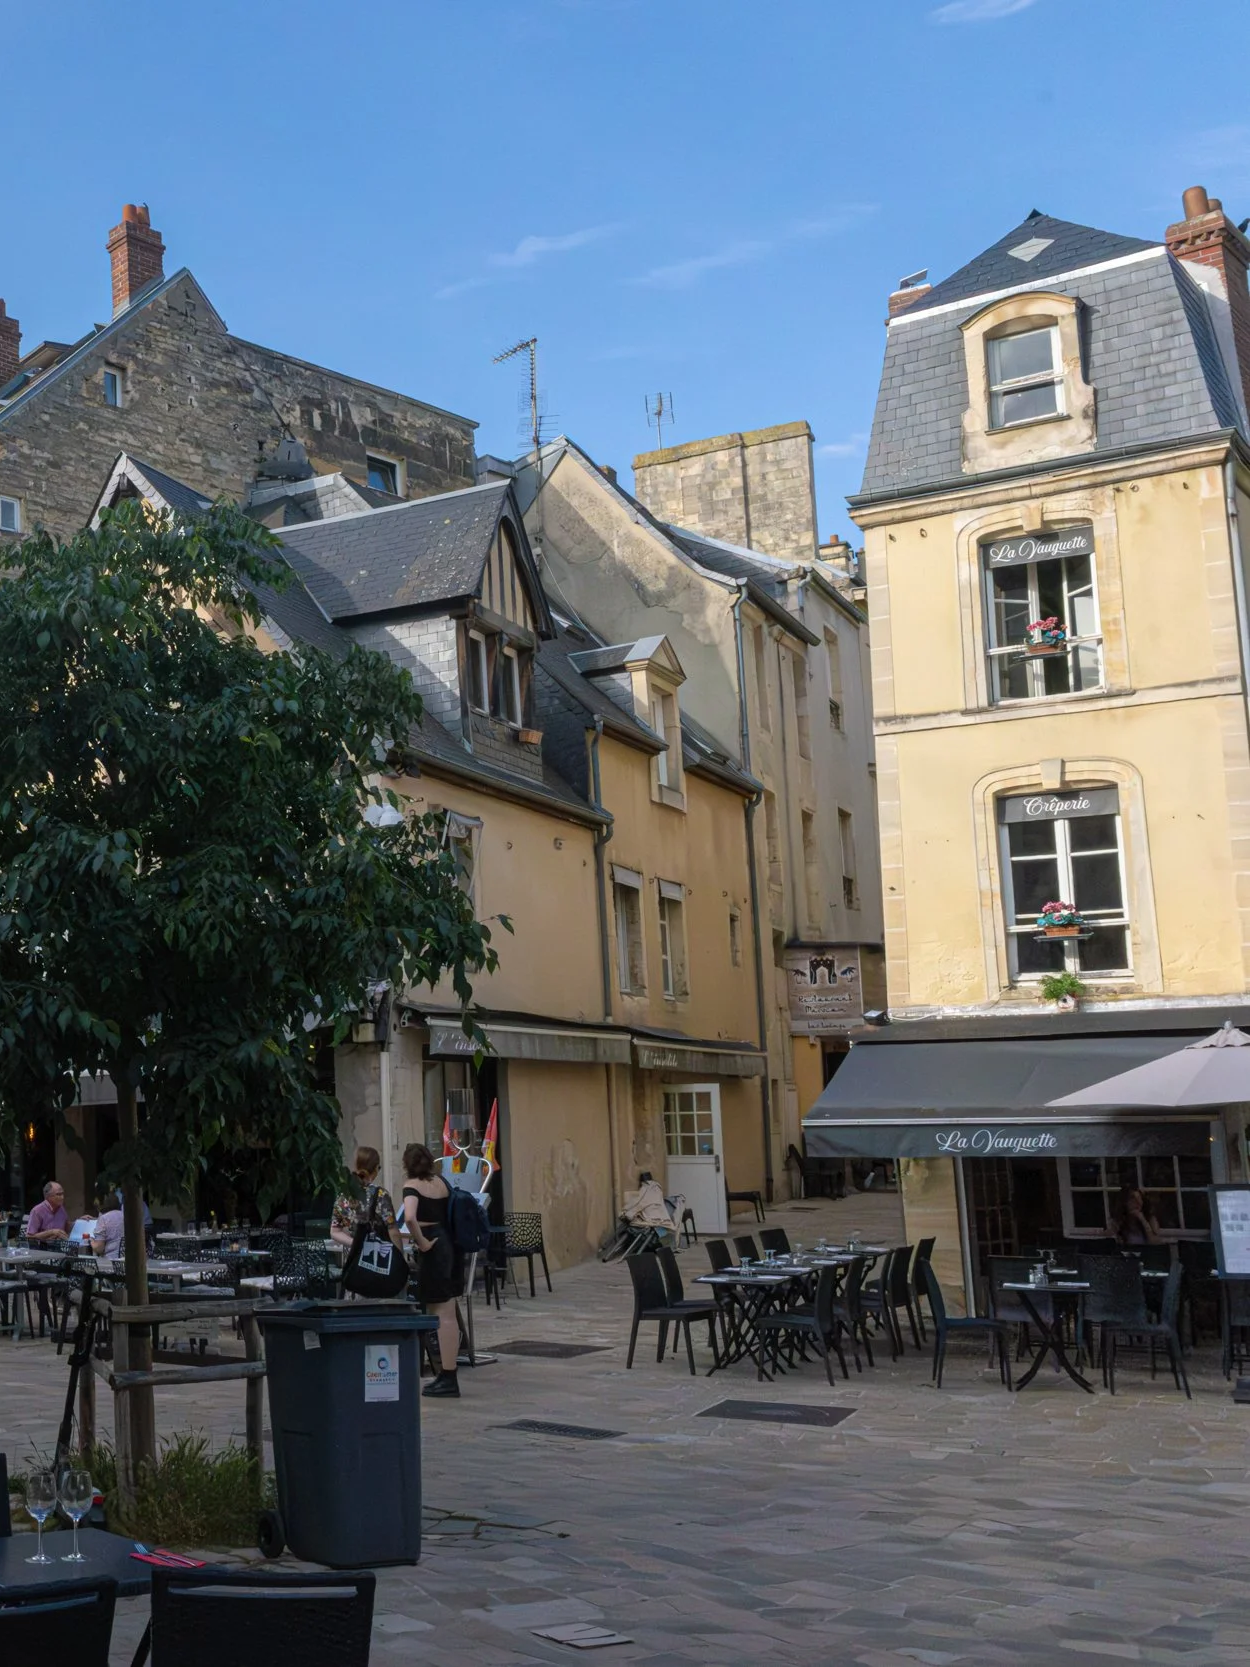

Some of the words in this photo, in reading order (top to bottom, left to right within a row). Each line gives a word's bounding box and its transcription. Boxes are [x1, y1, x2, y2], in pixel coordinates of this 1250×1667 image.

[990, 544, 1016, 562] La
[1018, 536, 1088, 560] Vauguette
[1023, 796, 1091, 816] Crêperie
[935, 1130, 969, 1153] La
[971, 1128, 1058, 1154] Vauguette
